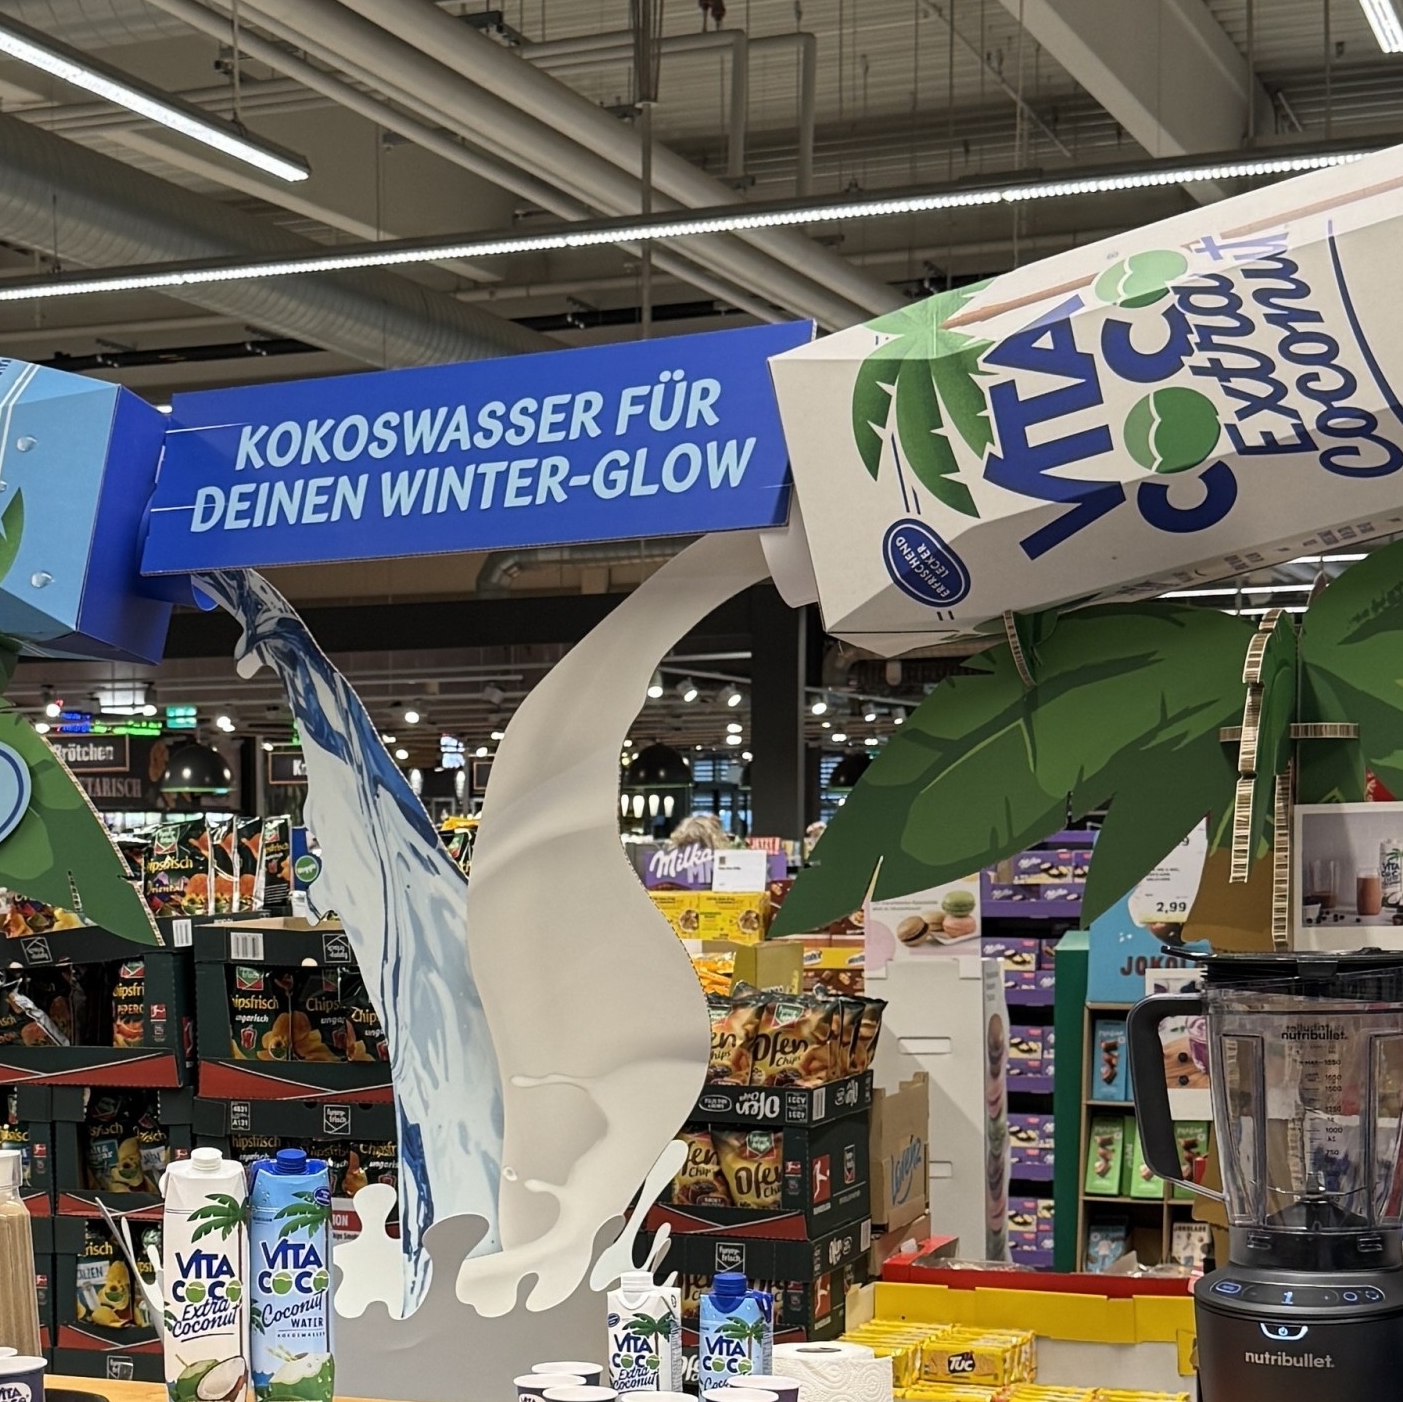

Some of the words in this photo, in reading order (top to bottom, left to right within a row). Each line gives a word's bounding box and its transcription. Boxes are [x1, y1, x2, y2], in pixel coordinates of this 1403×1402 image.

[1171, 274, 1319, 455] Extra
[1095, 249, 1237, 533] COCO
[235, 389, 603, 471] KOKOSWASSER
[616, 369, 722, 435] FÜR
[982, 295, 1126, 560] VITA
[190, 474, 369, 533] DEINEN
[380, 437, 757, 518] WINTER-GLOW
[895, 536, 950, 598] ERFRISCHEND
[916, 543, 950, 578] LECKER
[649, 842, 713, 878] Milka
[711, 1031, 737, 1050] en
[753, 1031, 809, 1067] Ofen
[175, 1248, 235, 1279] VITA
[261, 1238, 323, 1269] VITA
[172, 1279, 242, 1303] COCO
[258, 1270, 330, 1294] COCO
[172, 1305, 239, 1338] Coconut
[182, 1299, 230, 1321] Extra
[262, 1288, 326, 1328] Coconut
[291, 1317, 324, 1328] WATER
[614, 1332, 653, 1353] VITA
[705, 1335, 746, 1357] VITA
[612, 1353, 660, 1370] COCO
[618, 1366, 649, 1380] Extra
[703, 1356, 753, 1374] COCO
[613, 1373, 658, 1391] Coconut
